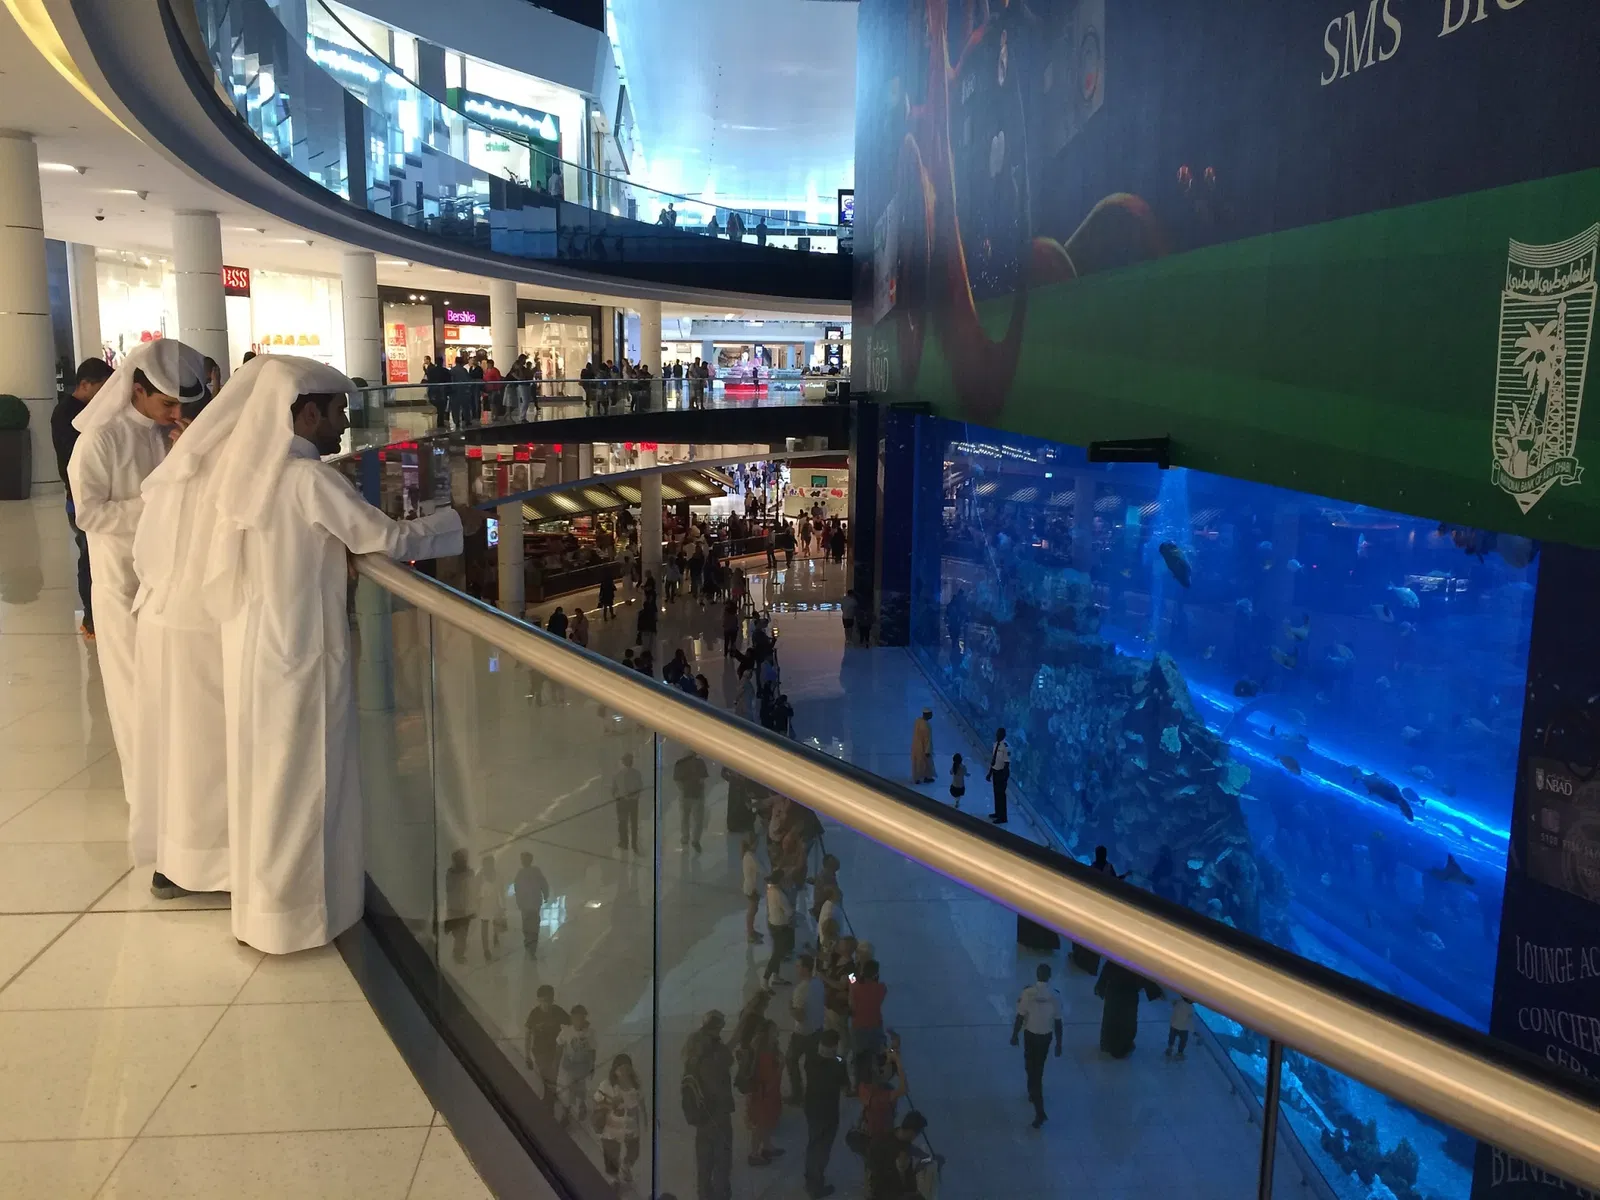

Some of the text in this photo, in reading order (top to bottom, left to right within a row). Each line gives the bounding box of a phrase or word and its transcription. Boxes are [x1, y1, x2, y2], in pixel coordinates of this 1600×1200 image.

[1320, 0, 1402, 86] SMS
[447, 309, 476, 323] Bershka
[1545, 777, 1573, 796] NBAD
[1516, 935, 1575, 984] LOUNGE
